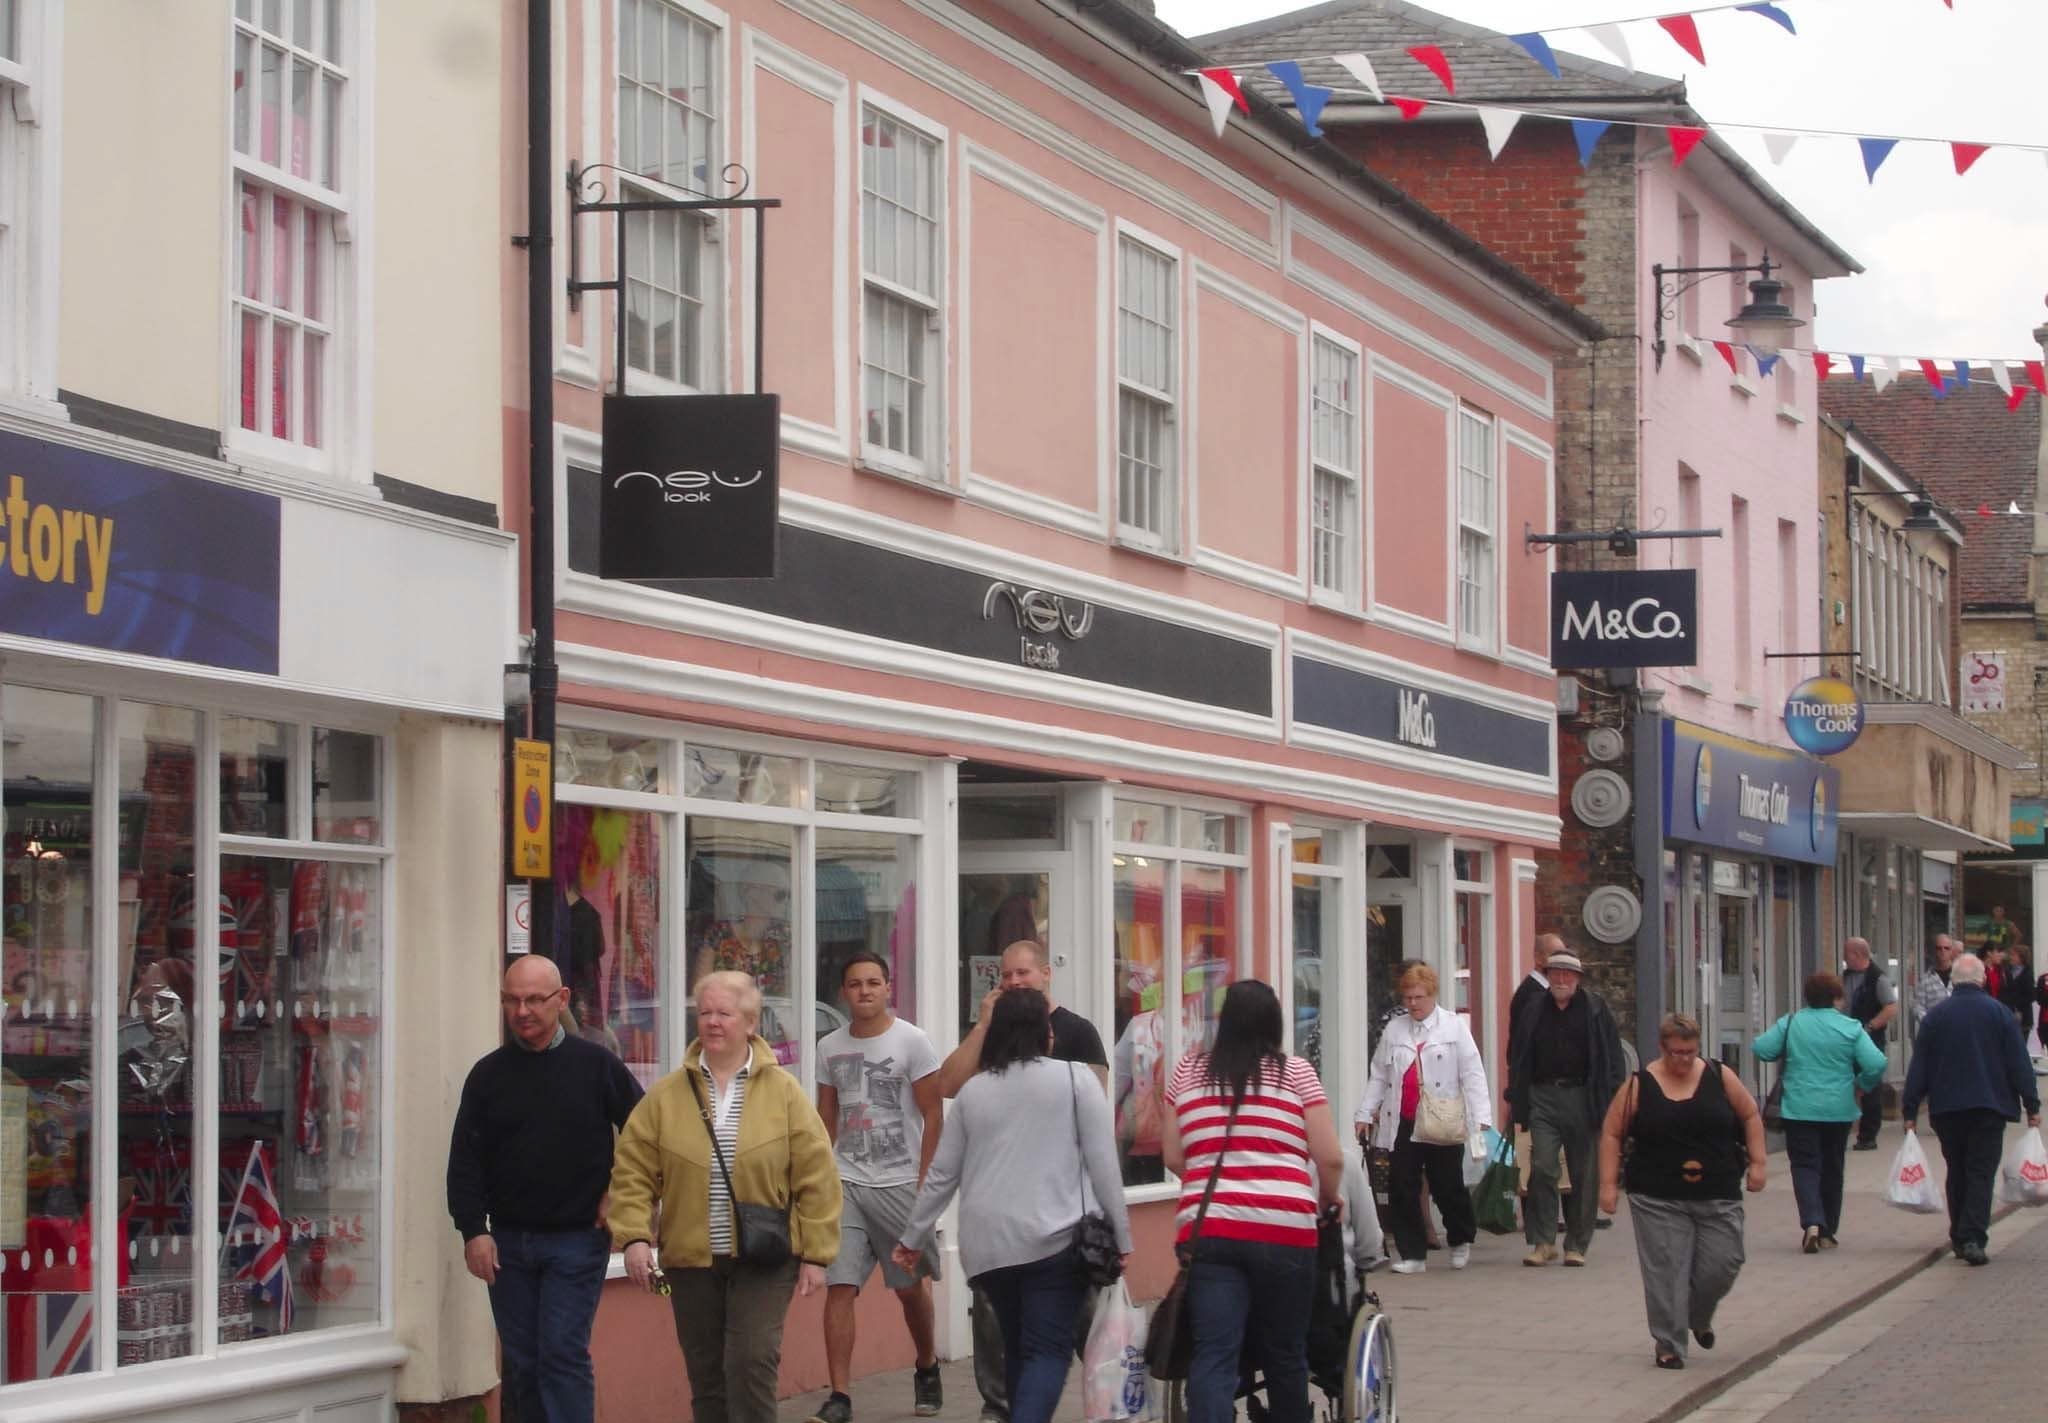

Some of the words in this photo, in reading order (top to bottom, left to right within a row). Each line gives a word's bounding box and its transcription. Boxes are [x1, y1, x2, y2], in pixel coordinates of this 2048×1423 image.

[664, 491, 711, 502] look
[0, 474, 114, 616] tory
[1561, 597, 1686, 640] M&Co.
[1020, 635, 1060, 670] look
[1788, 700, 1857, 717] Thomas
[1815, 716, 1857, 733] Cook
[1739, 773, 1771, 822] Thomas
[1770, 781, 1790, 825] Cook
